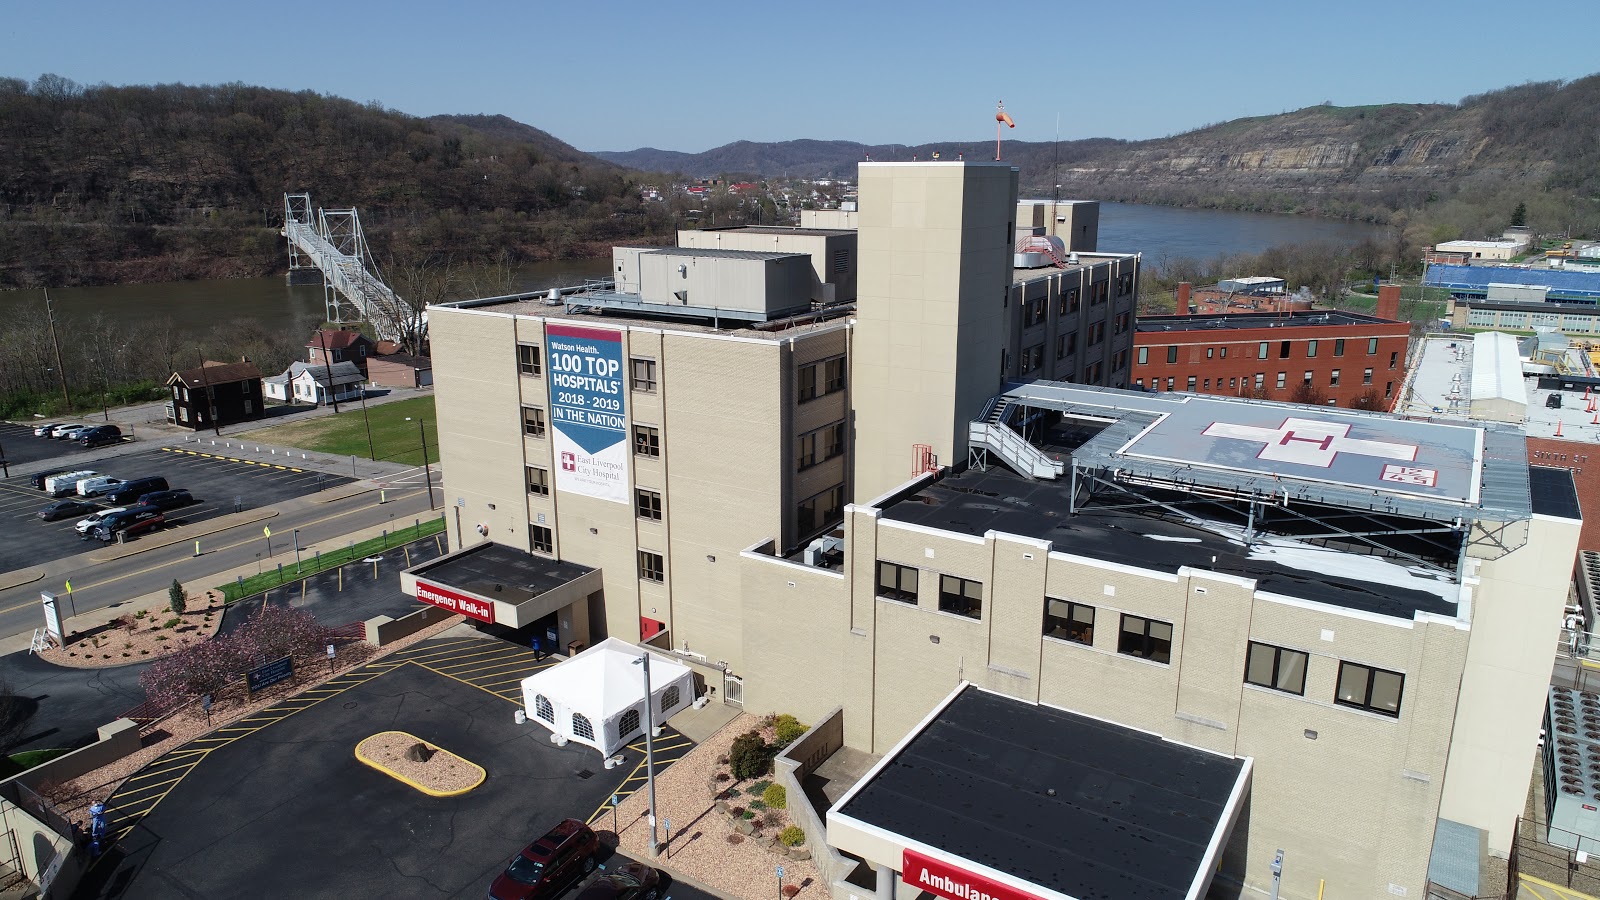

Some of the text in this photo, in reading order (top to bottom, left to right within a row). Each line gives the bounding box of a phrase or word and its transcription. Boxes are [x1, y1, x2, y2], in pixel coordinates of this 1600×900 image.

[552, 341, 575, 352] Watson
[552, 352, 619, 377] 100 TOP
[558, 391, 585, 405] 2018
[592, 396, 620, 411] 2019
[553, 407, 625, 428] IN THE NATION
[1279, 431, 1335, 450] H
[577, 455, 623, 471] East Liverpool
[1533, 450, 1588, 463] SIXTH ST
[577, 465, 620, 481] City Hospital
[417, 586, 489, 618] Emergency Walk-in
